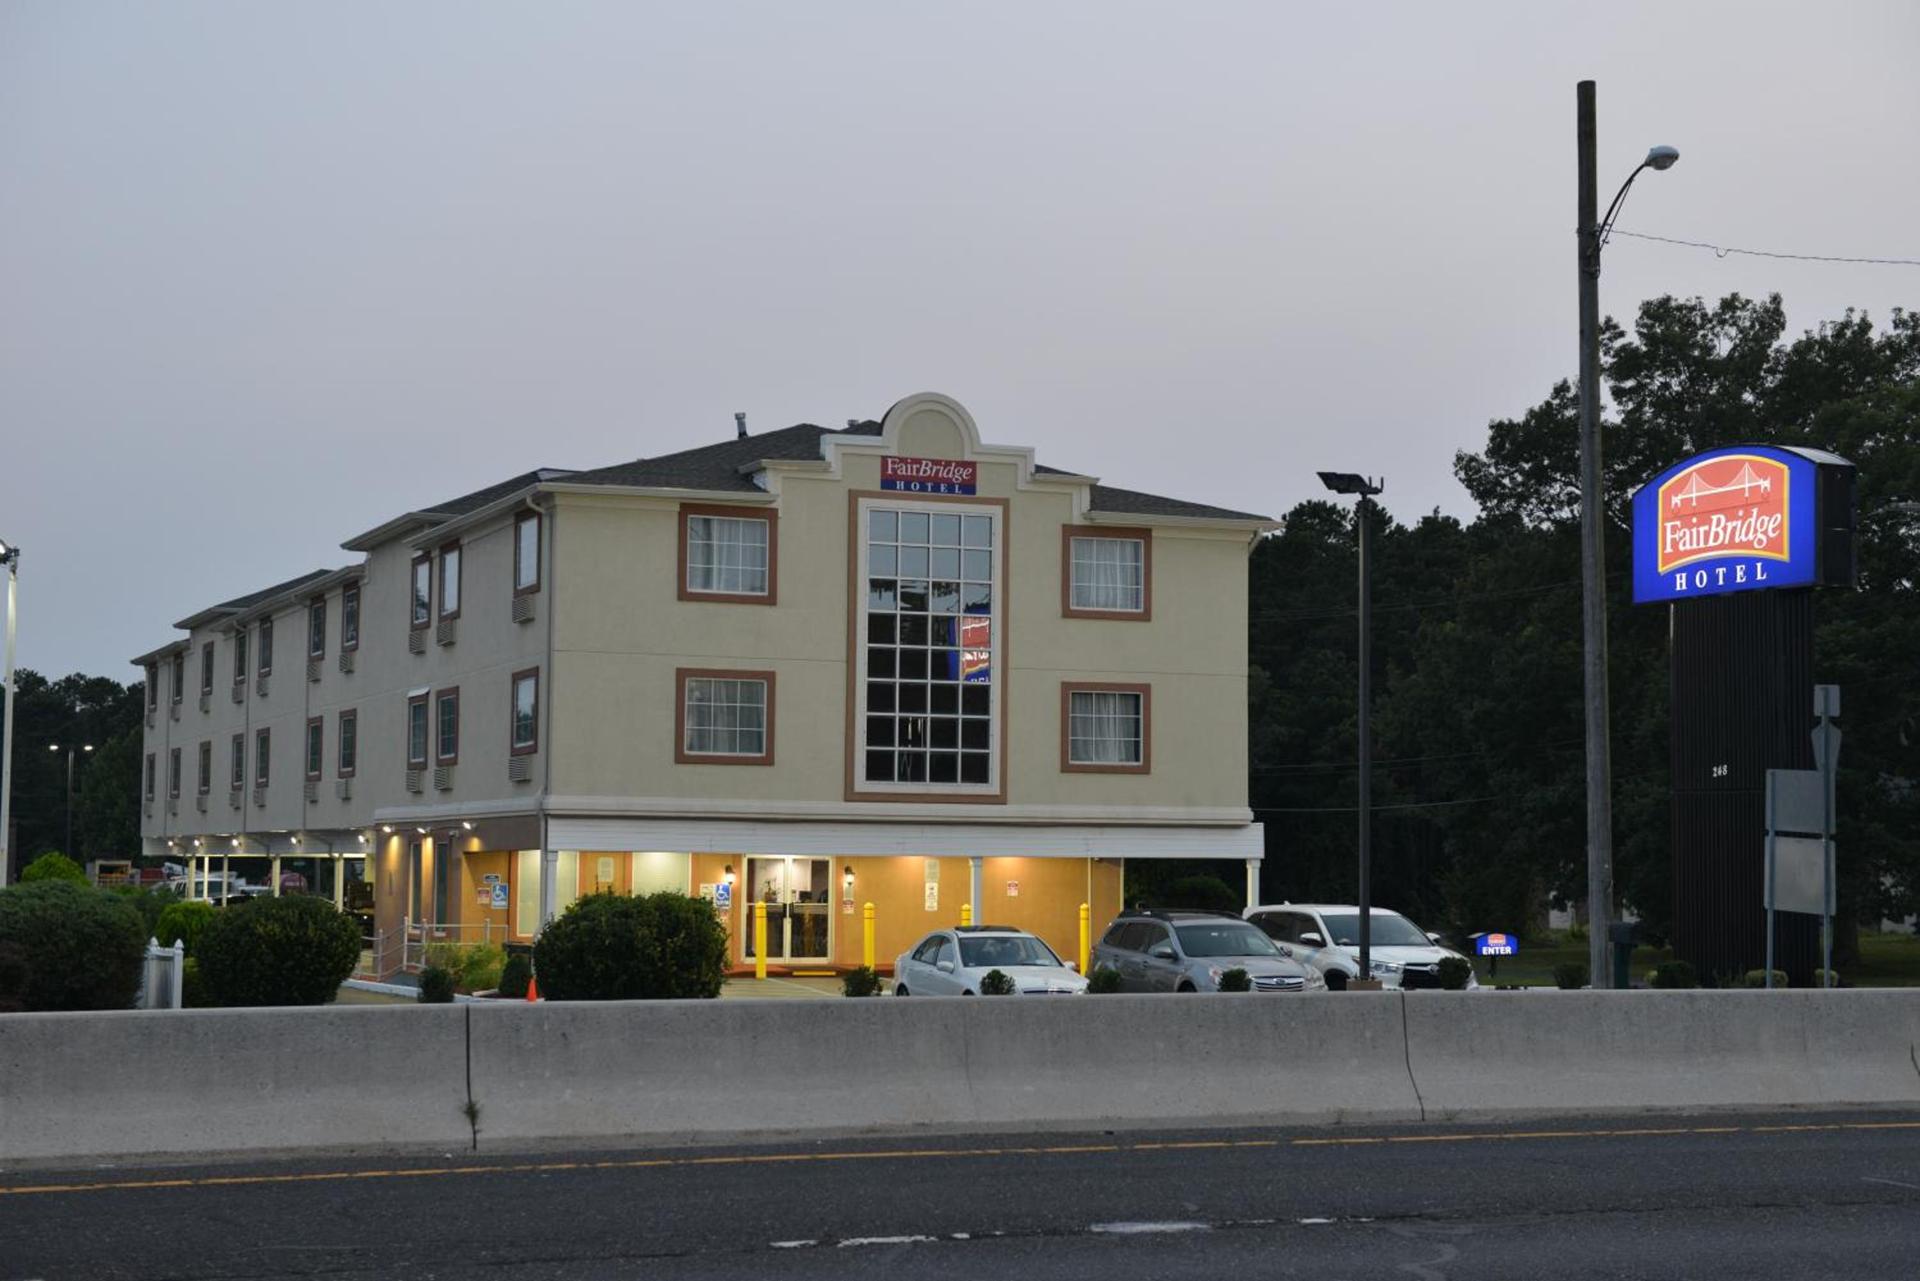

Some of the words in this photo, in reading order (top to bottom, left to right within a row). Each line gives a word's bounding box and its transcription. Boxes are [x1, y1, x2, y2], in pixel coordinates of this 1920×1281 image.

[886, 458, 972, 483] FairBridge
[896, 480, 962, 494] HOTEL
[1663, 508, 1782, 553] FairBridge
[1675, 562, 1767, 591] HOTEL
[1482, 946, 1512, 956] ENTER
